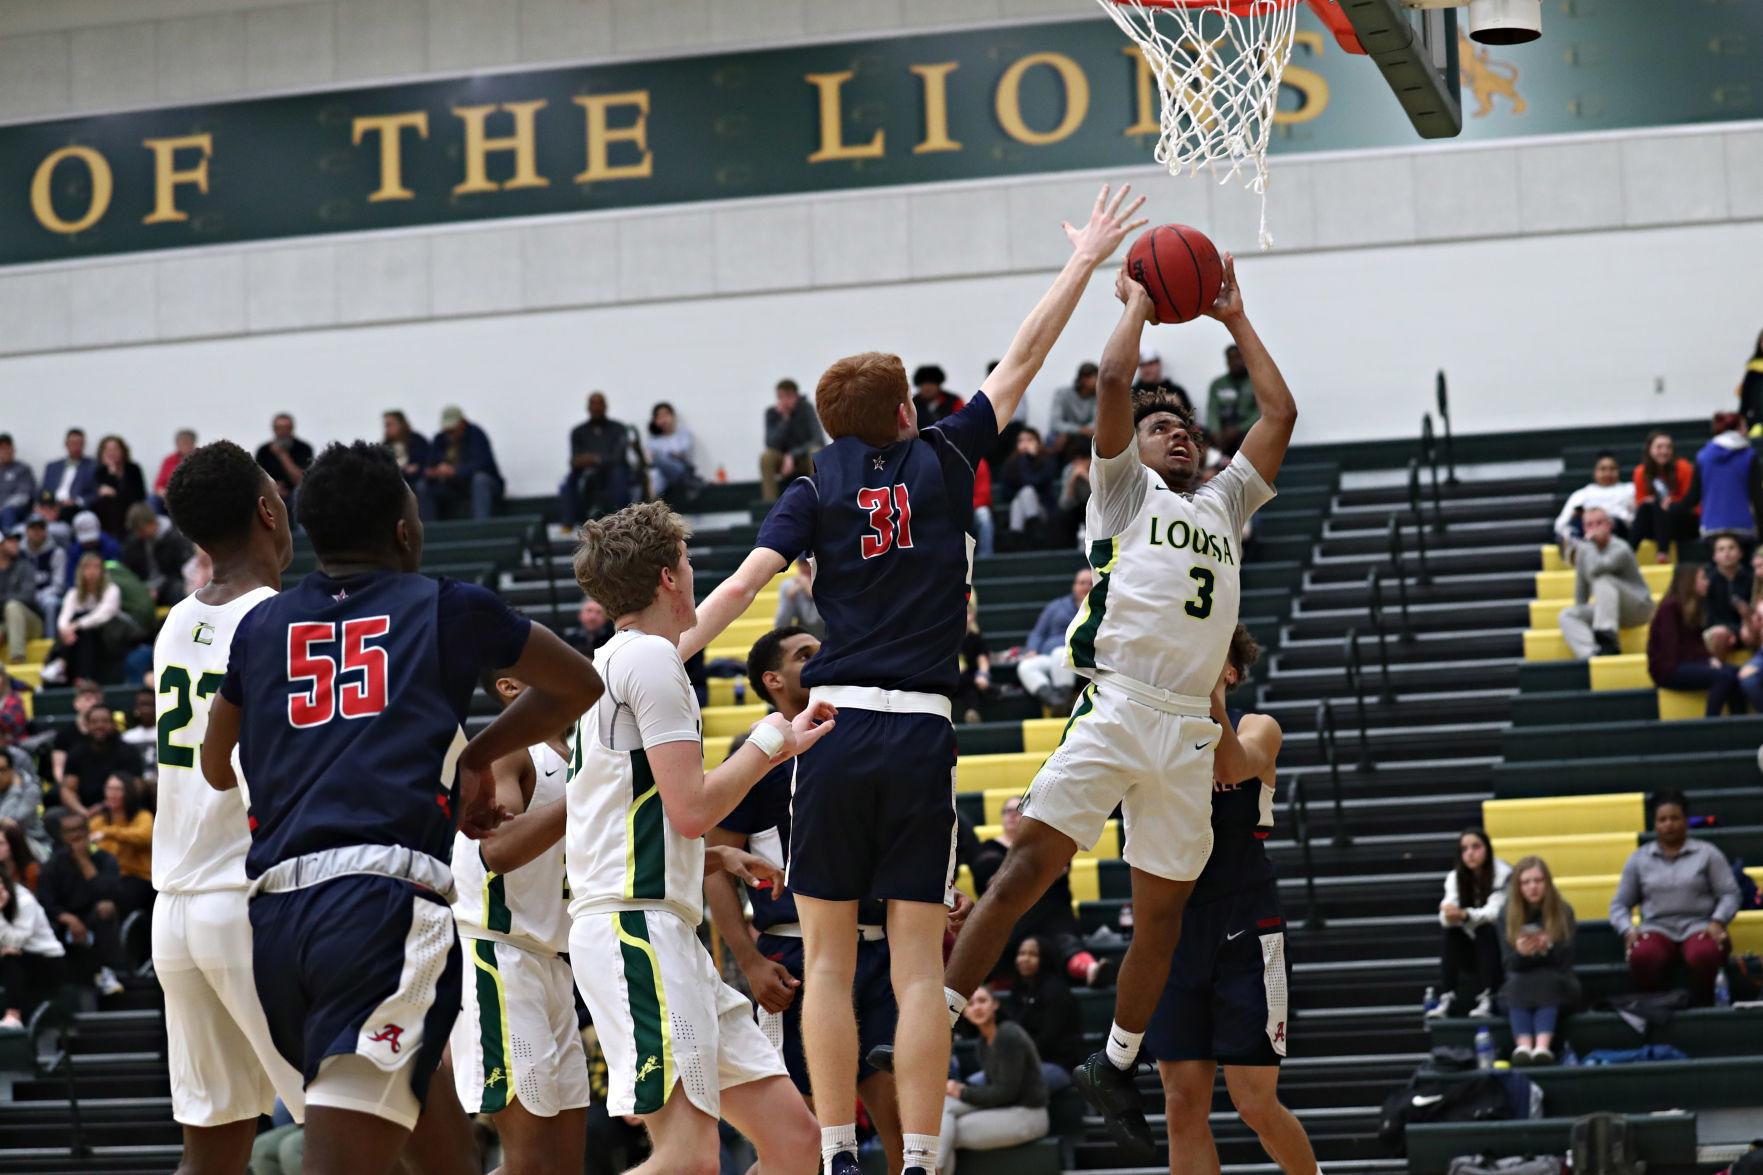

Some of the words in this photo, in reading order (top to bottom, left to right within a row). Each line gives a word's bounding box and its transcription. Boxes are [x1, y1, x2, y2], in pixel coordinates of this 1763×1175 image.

[29, 133, 213, 235] OF
[352, 90, 654, 203] THE
[805, 31, 1330, 163] LIONS
[856, 482, 914, 560] 31
[1183, 564, 1216, 620] 3
[287, 614, 390, 729] 55
